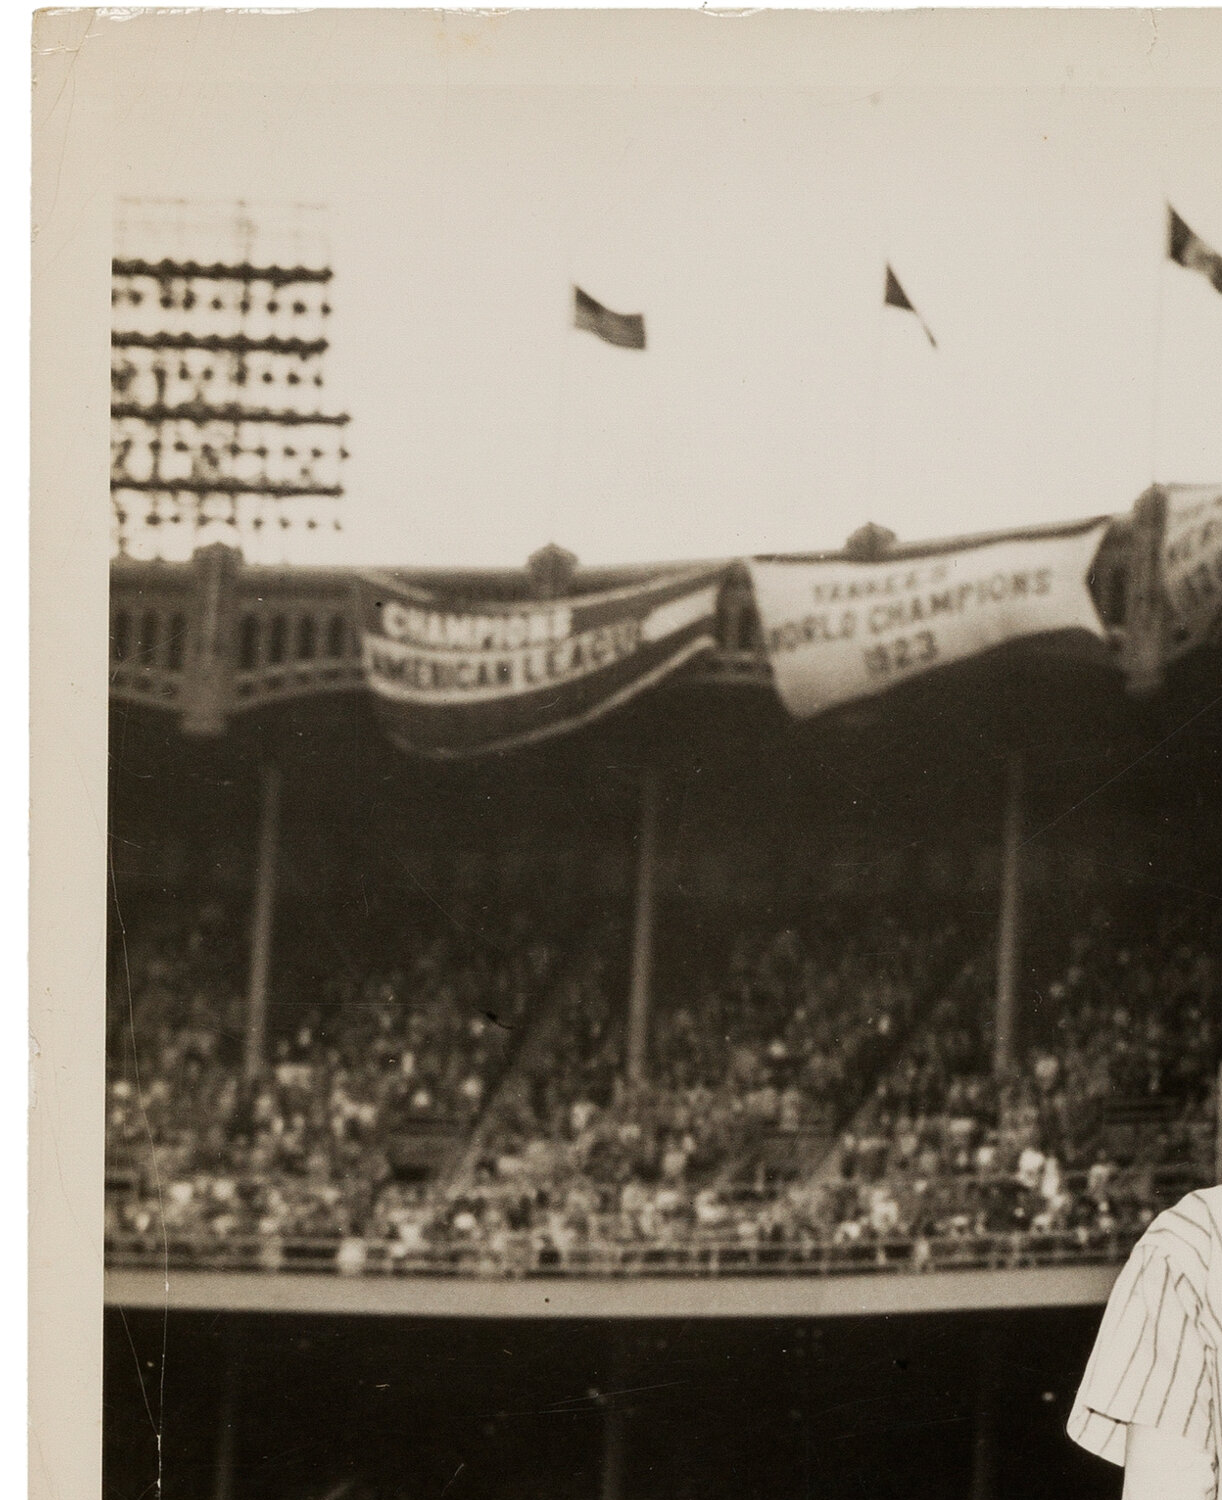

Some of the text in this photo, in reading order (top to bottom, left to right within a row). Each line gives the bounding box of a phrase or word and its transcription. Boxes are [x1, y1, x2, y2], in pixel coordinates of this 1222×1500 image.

[381, 600, 574, 654] CHAMPIONS
[867, 564, 1052, 636] CHAMPIONS
[522, 617, 639, 687] LEAGU
